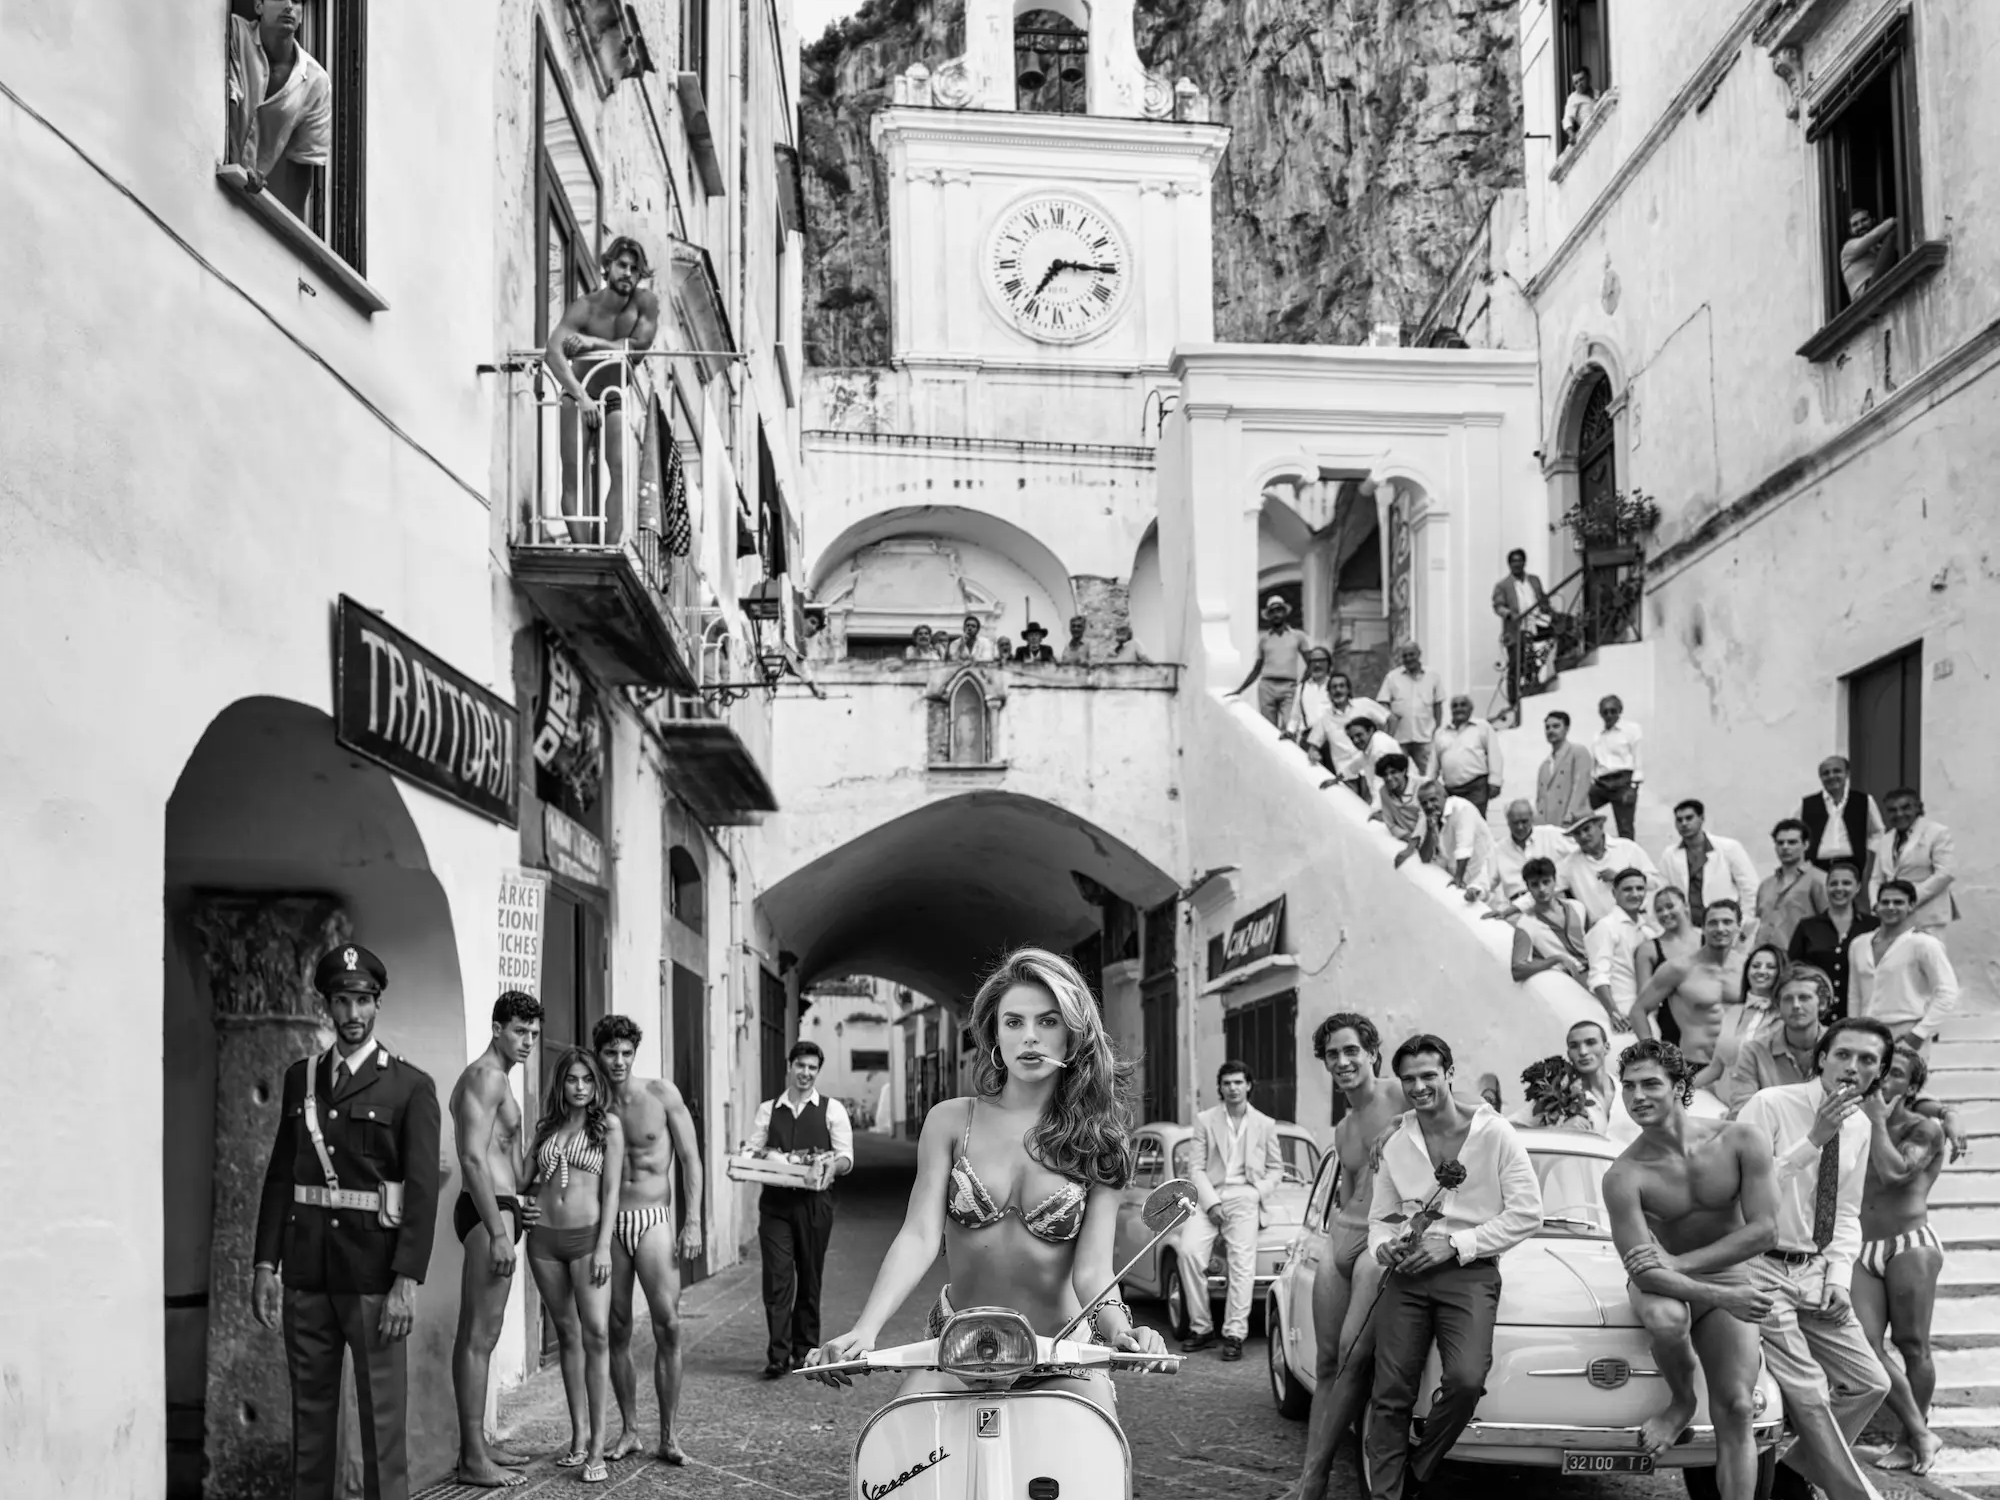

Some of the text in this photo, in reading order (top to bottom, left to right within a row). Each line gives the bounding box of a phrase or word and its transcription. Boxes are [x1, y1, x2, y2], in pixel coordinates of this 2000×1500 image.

[360, 628, 513, 806] TRATTORIA
[497, 932, 537, 956] ICHES
[1569, 1456, 1614, 1471] 32100
[861, 1462, 929, 1500] Vespa
